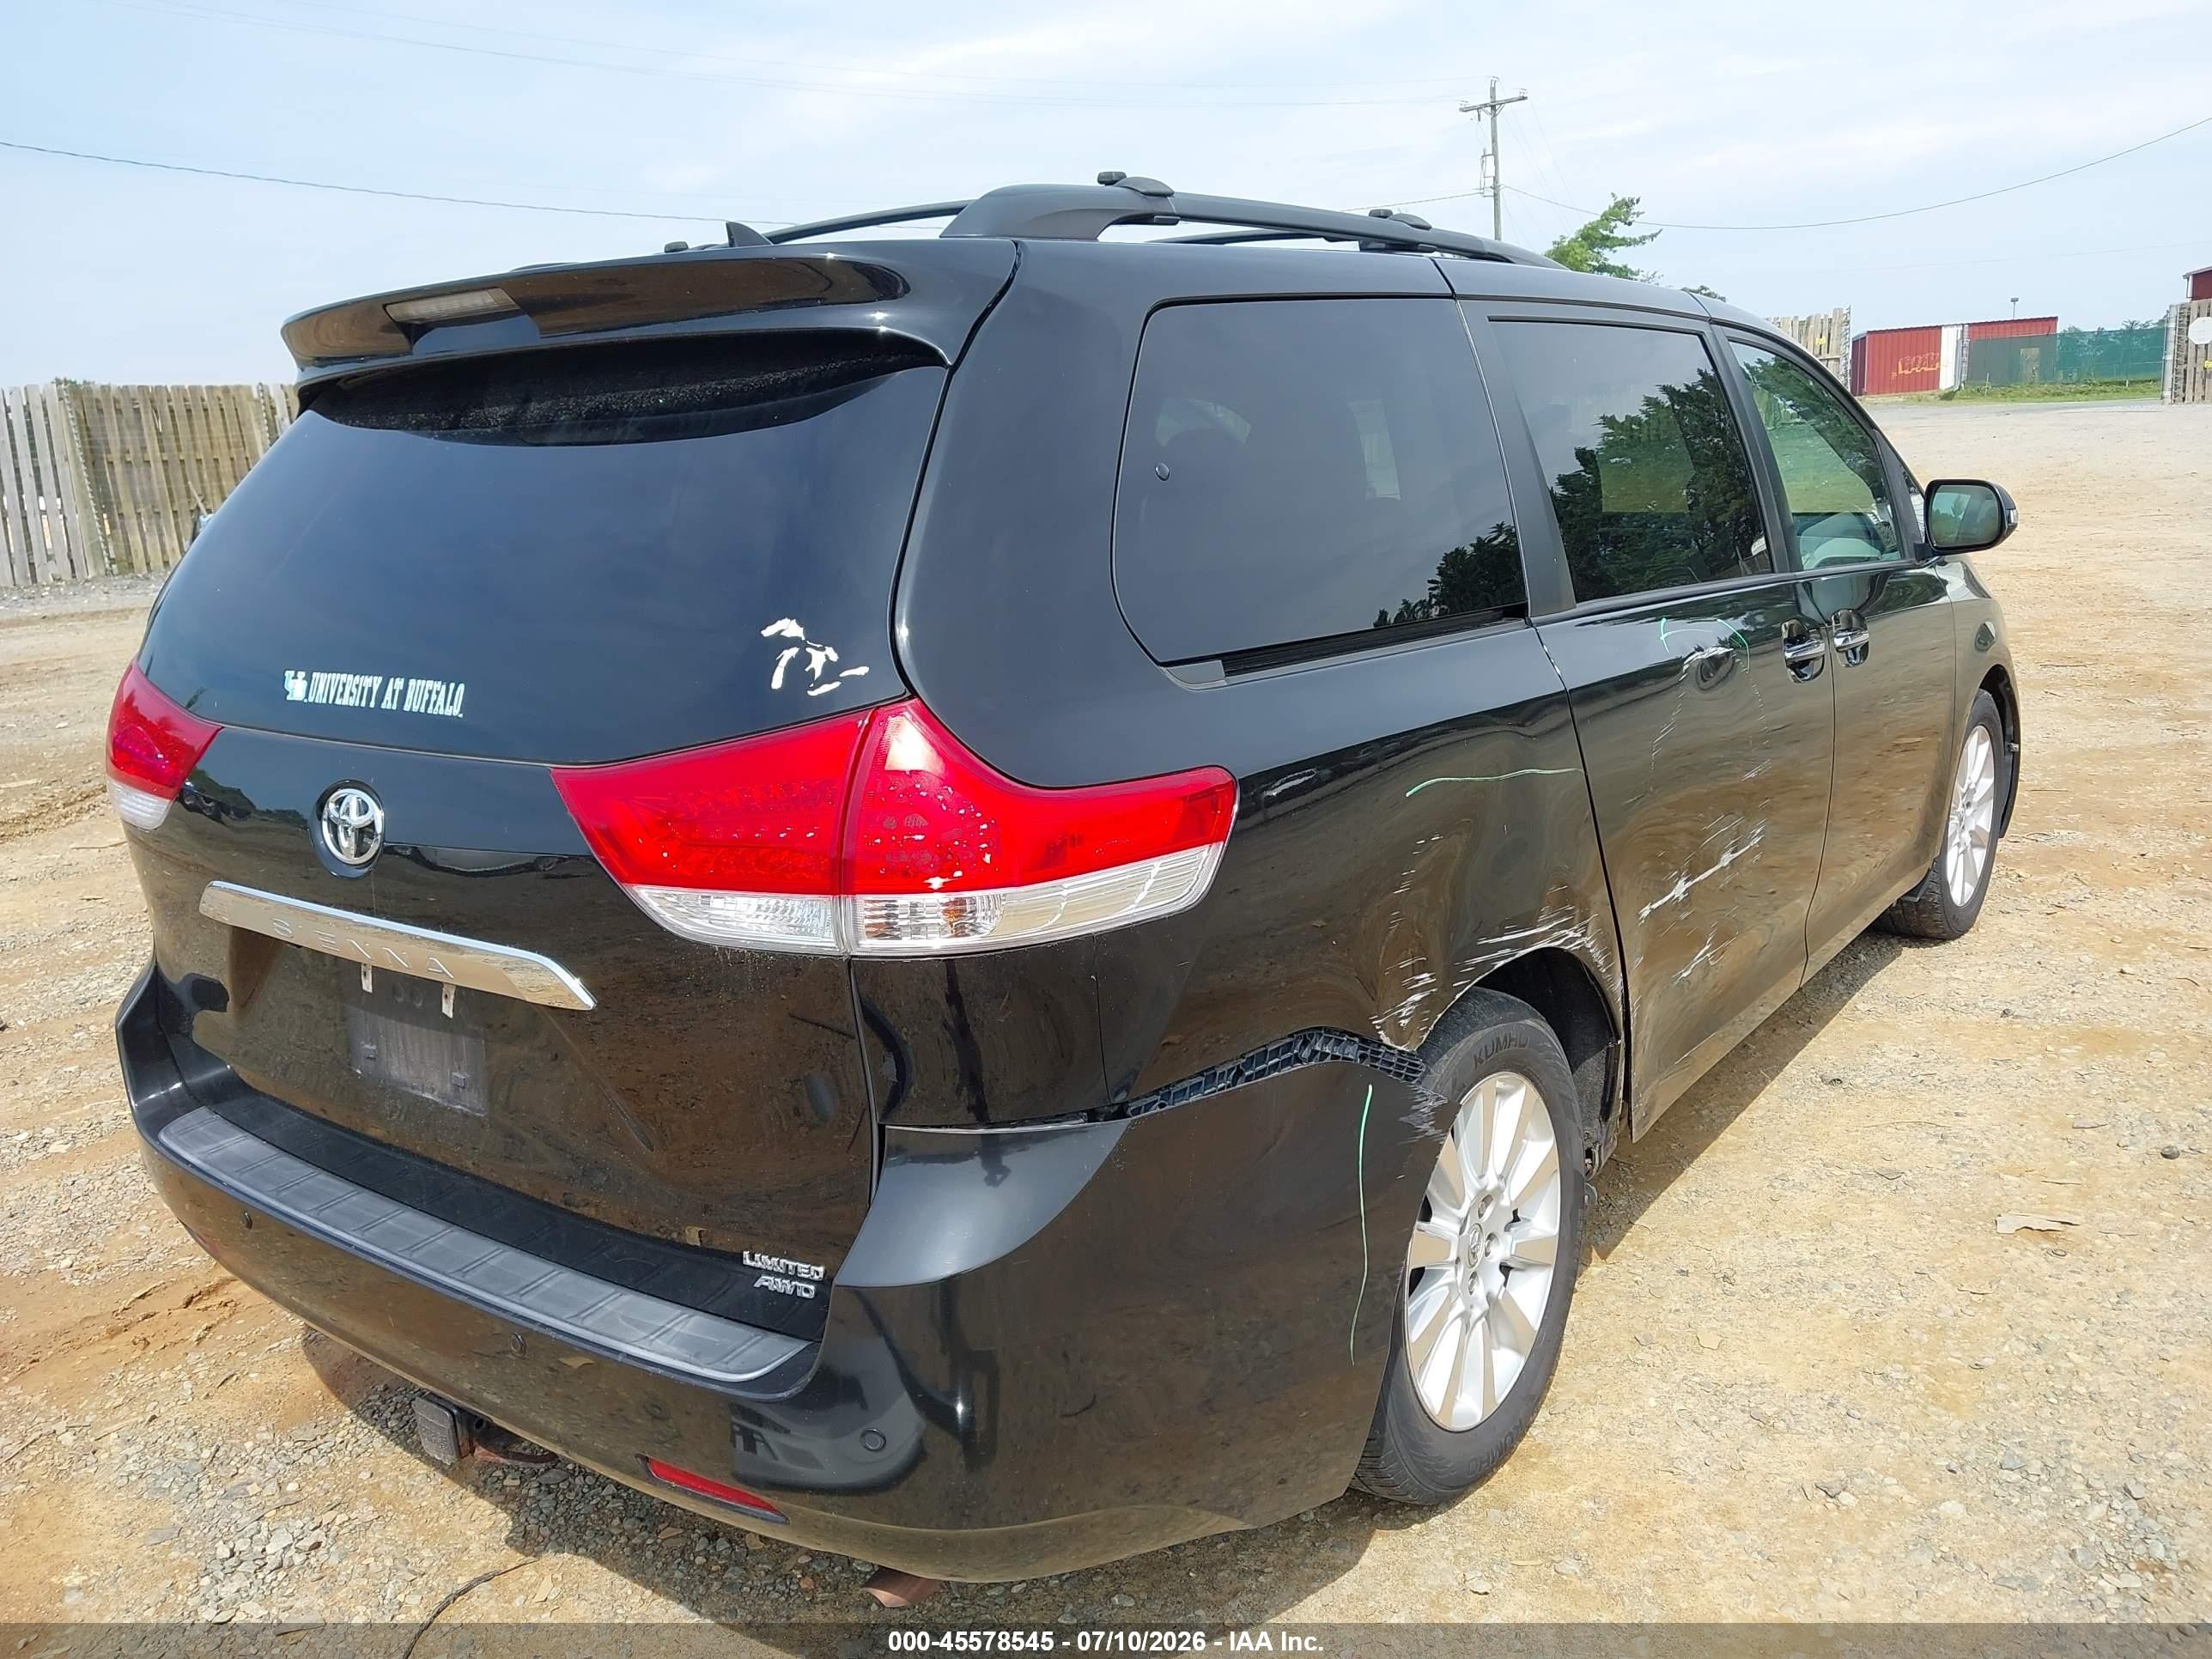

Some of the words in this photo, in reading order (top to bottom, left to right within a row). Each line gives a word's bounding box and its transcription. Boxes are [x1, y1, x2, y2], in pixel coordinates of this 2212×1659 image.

[307, 672, 383, 708] UNIVERSITY
[380, 677, 404, 710] AT
[742, 1250, 825, 1281] LIMITED
[754, 1274, 817, 1299] AWD
